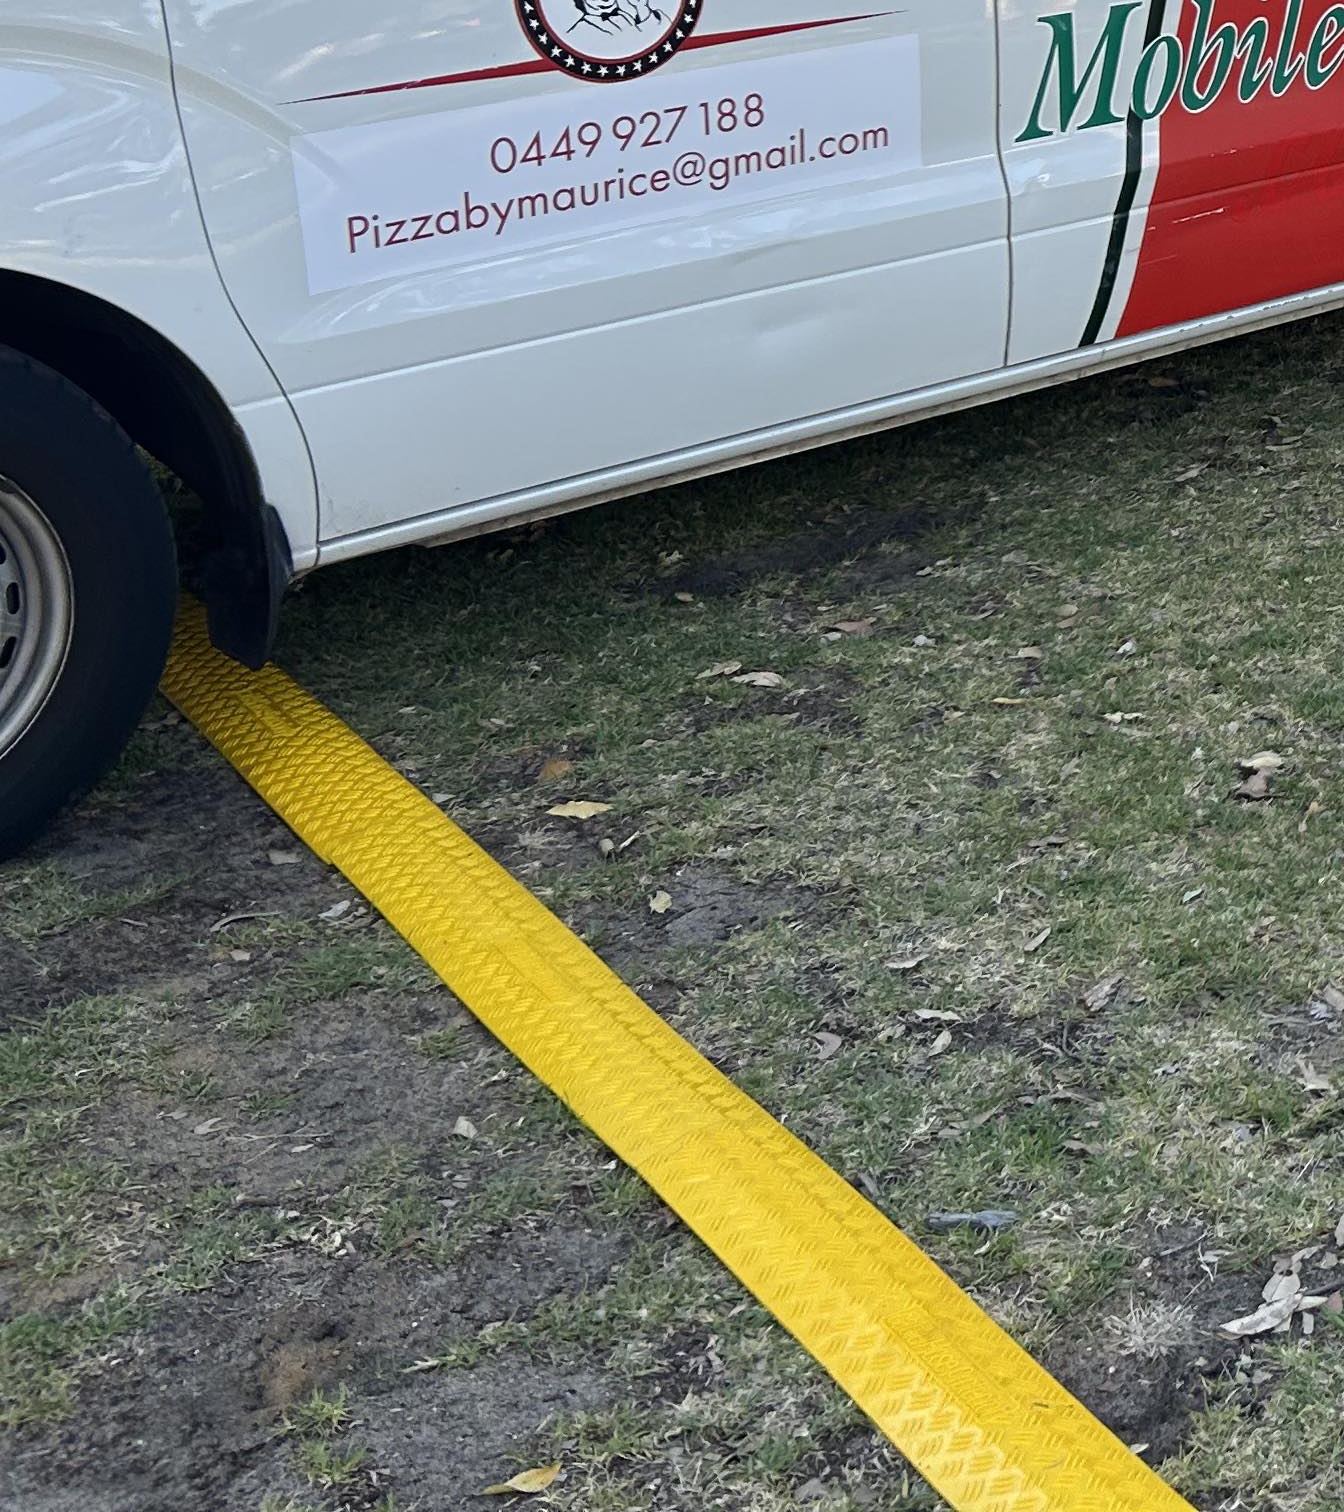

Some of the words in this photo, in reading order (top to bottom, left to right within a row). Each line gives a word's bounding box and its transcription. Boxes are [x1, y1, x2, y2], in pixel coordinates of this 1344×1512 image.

[490, 121, 602, 174] 0449
[611, 104, 689, 152] 927
[698, 92, 765, 136] 188
[347, 126, 890, 254] Pizzabymaurice@gmail.com
